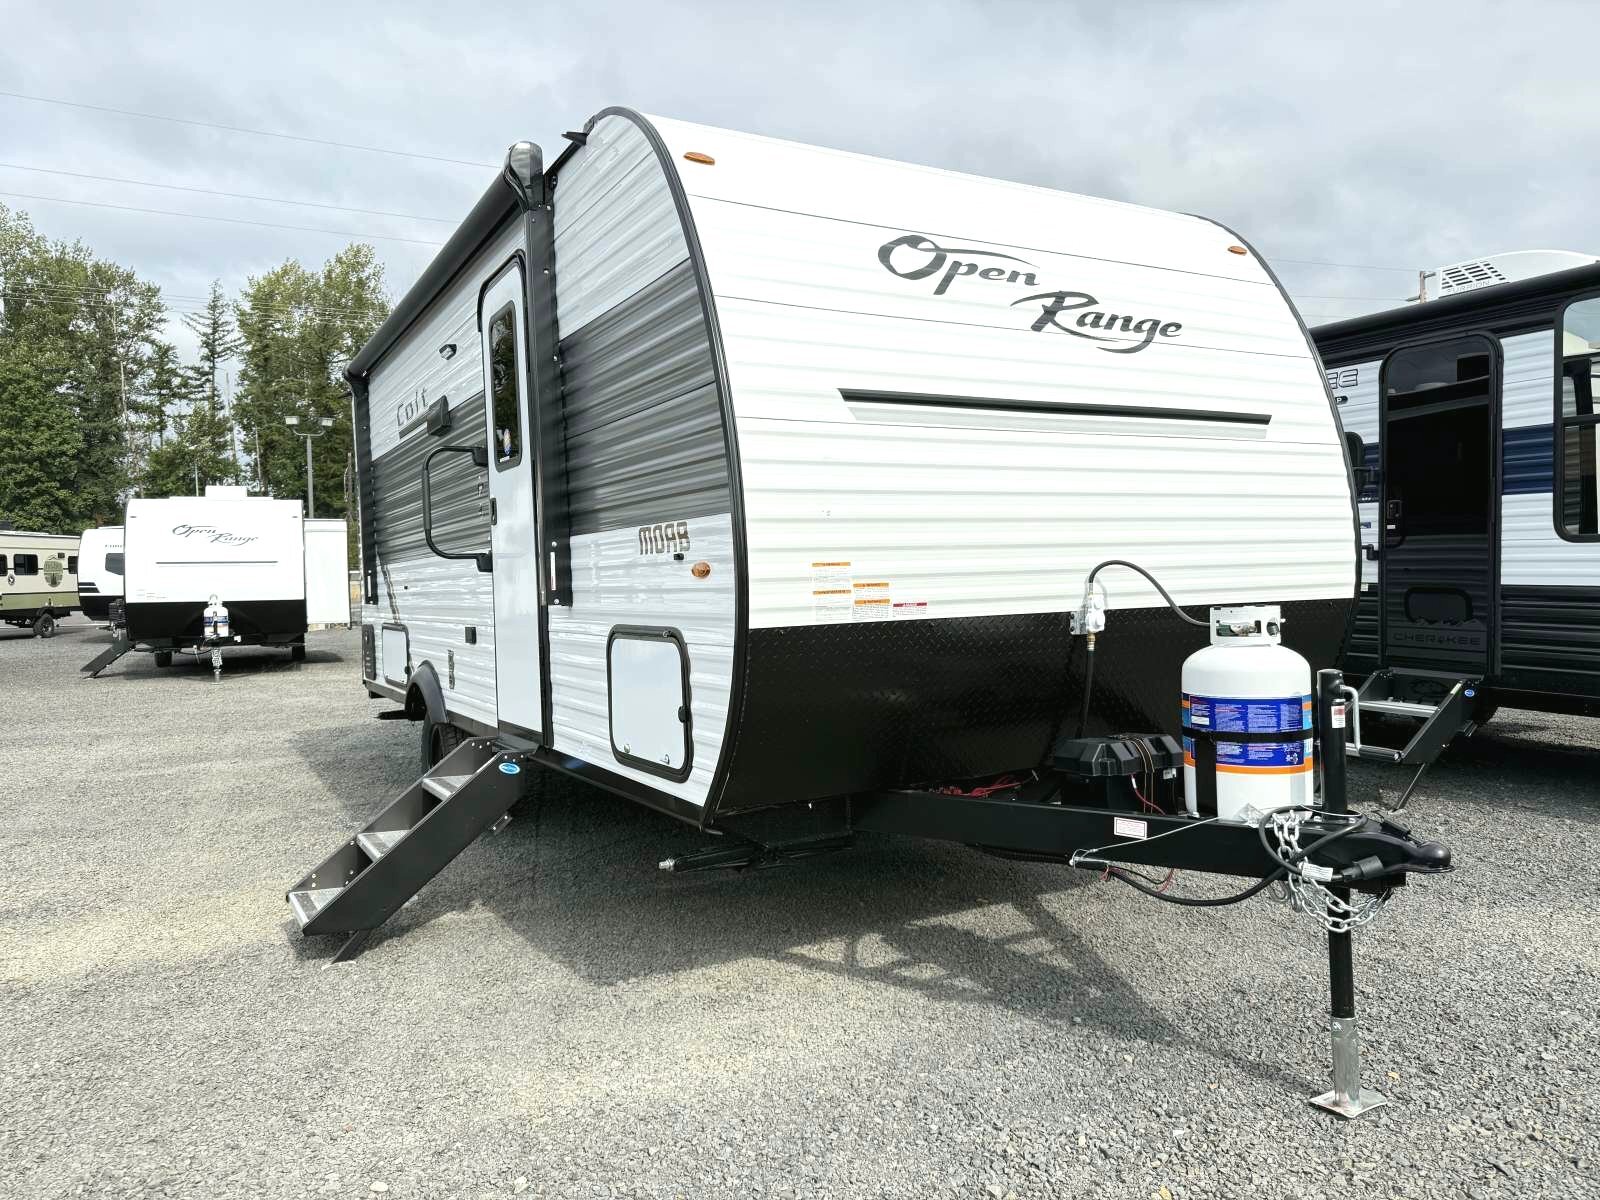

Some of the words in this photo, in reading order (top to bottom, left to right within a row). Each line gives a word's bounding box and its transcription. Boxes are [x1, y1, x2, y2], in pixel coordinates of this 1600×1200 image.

[877, 234, 1040, 295] Open
[1010, 290, 1183, 353] Range
[397, 387, 427, 426] Colt
[172, 524, 217, 538] Open
[208, 532, 258, 546] Range
[639, 521, 690, 555] MOAB
